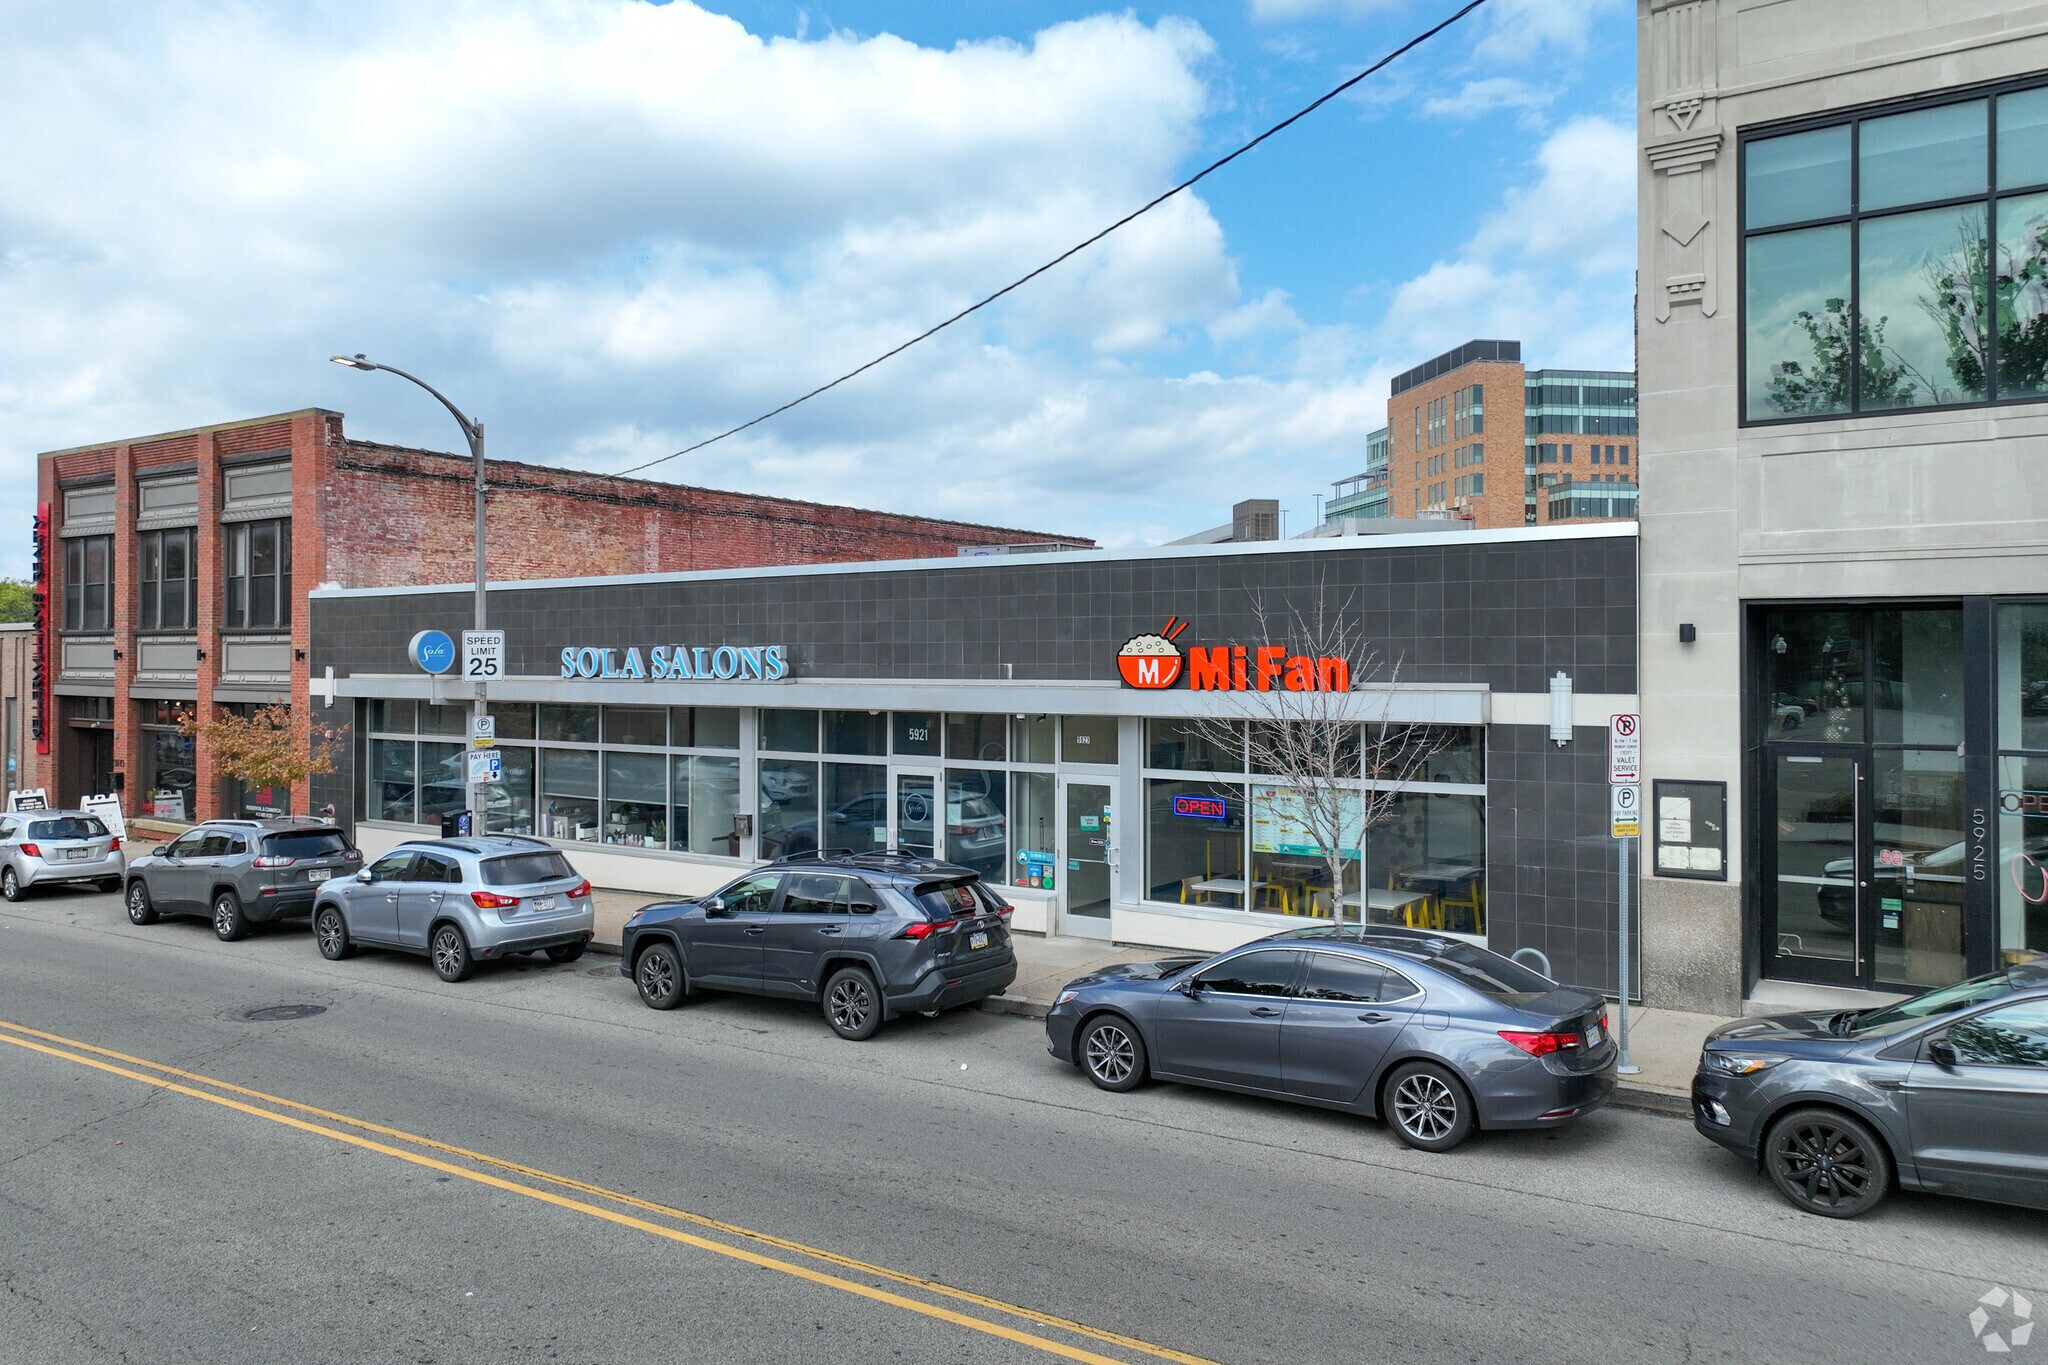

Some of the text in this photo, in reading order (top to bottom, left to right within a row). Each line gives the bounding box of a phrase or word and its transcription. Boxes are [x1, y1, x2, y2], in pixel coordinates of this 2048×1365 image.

[32, 514, 46, 584] REALTY
[467, 636, 501, 645] SPEED
[421, 642, 450, 663] Sola
[471, 647, 497, 656] LIMIT
[469, 658, 498, 676] 25
[561, 645, 788, 680] SOLA SALONS
[1138, 658, 1159, 684] M
[1190, 646, 1349, 692] Mi Fan
[909, 728, 928, 741] 5921
[470, 751, 499, 761] PAY HERE
[492, 760, 499, 770] P
[1613, 764, 1639, 772] SERVICE
[1622, 791, 1631, 804] P
[1177, 799, 1223, 816] OPEN
[1973, 808, 1985, 881] 5925
